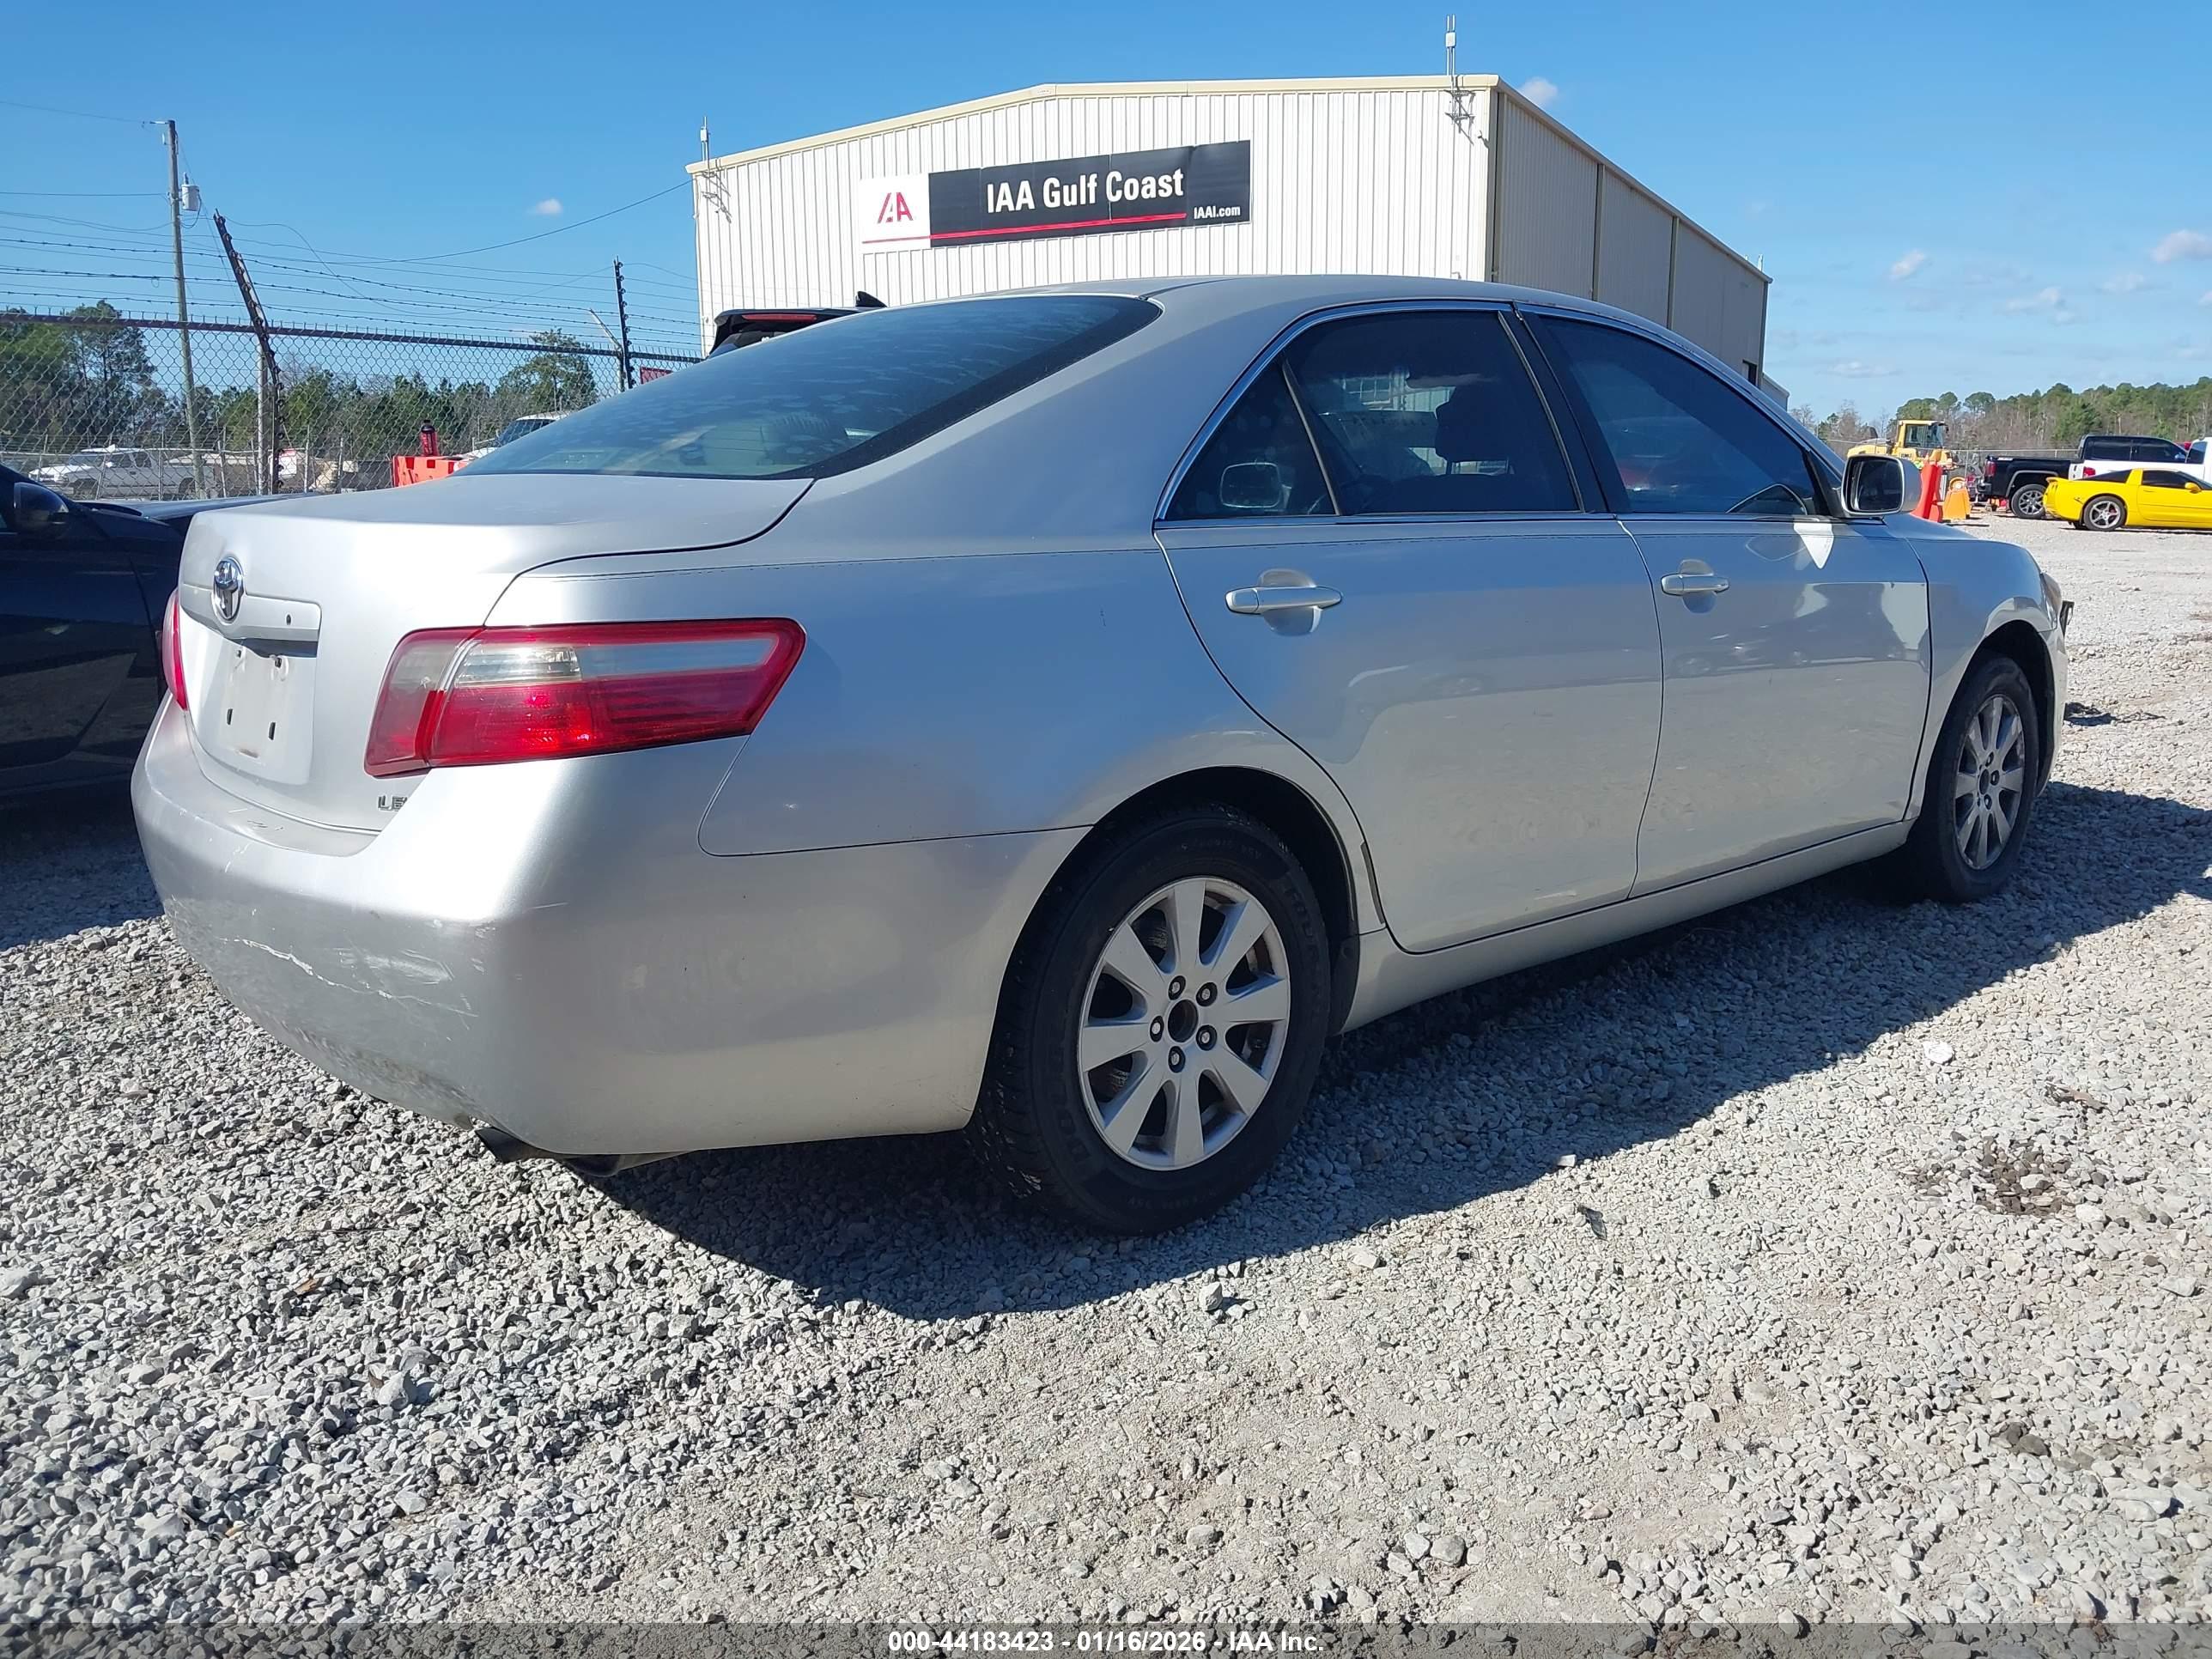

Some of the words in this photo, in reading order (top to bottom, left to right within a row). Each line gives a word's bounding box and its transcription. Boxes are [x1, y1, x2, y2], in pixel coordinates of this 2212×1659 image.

[987, 179, 1036, 213] IAA
[1042, 173, 1098, 209] Gulf
[1105, 167, 1184, 202] Coast
[1194, 205, 1241, 219] IAAI.com
